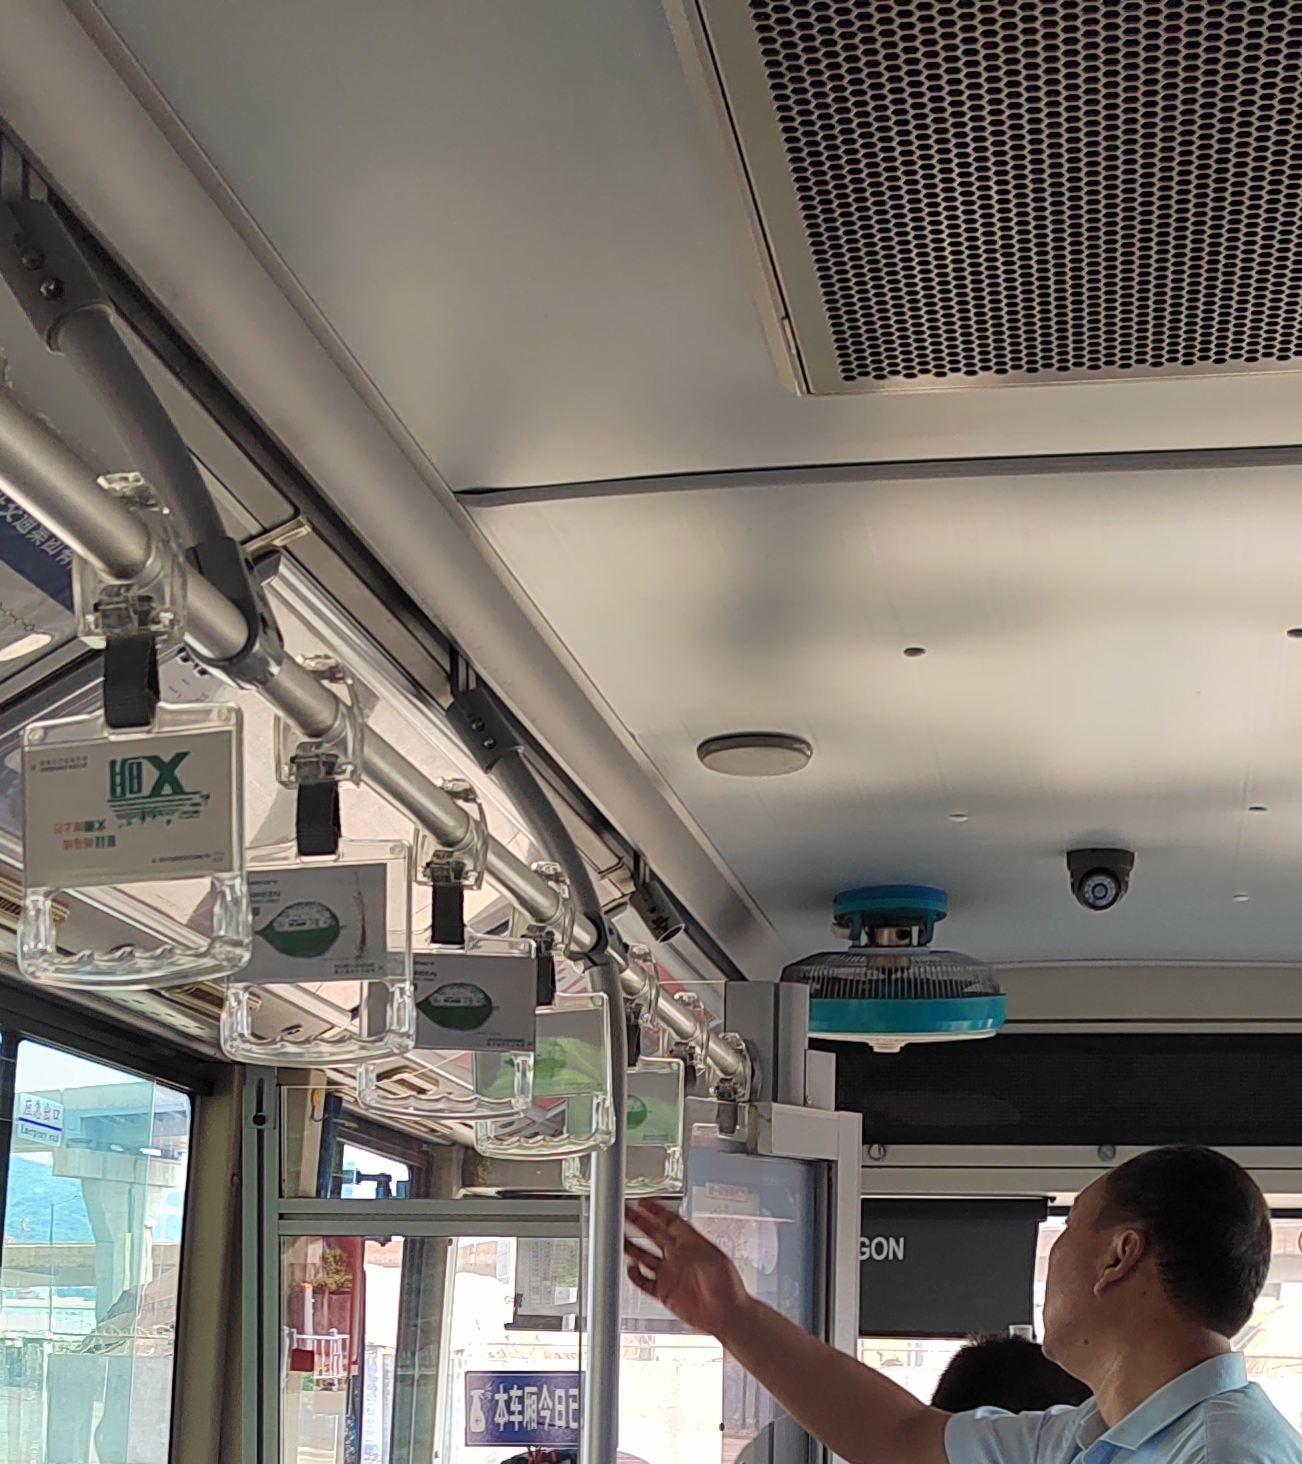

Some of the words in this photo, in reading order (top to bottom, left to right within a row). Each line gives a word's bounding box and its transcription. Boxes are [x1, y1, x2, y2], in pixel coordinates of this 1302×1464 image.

[23, 1096, 61, 1121] 应急出口
[494, 1383, 579, 1431] 本车厢今日已
